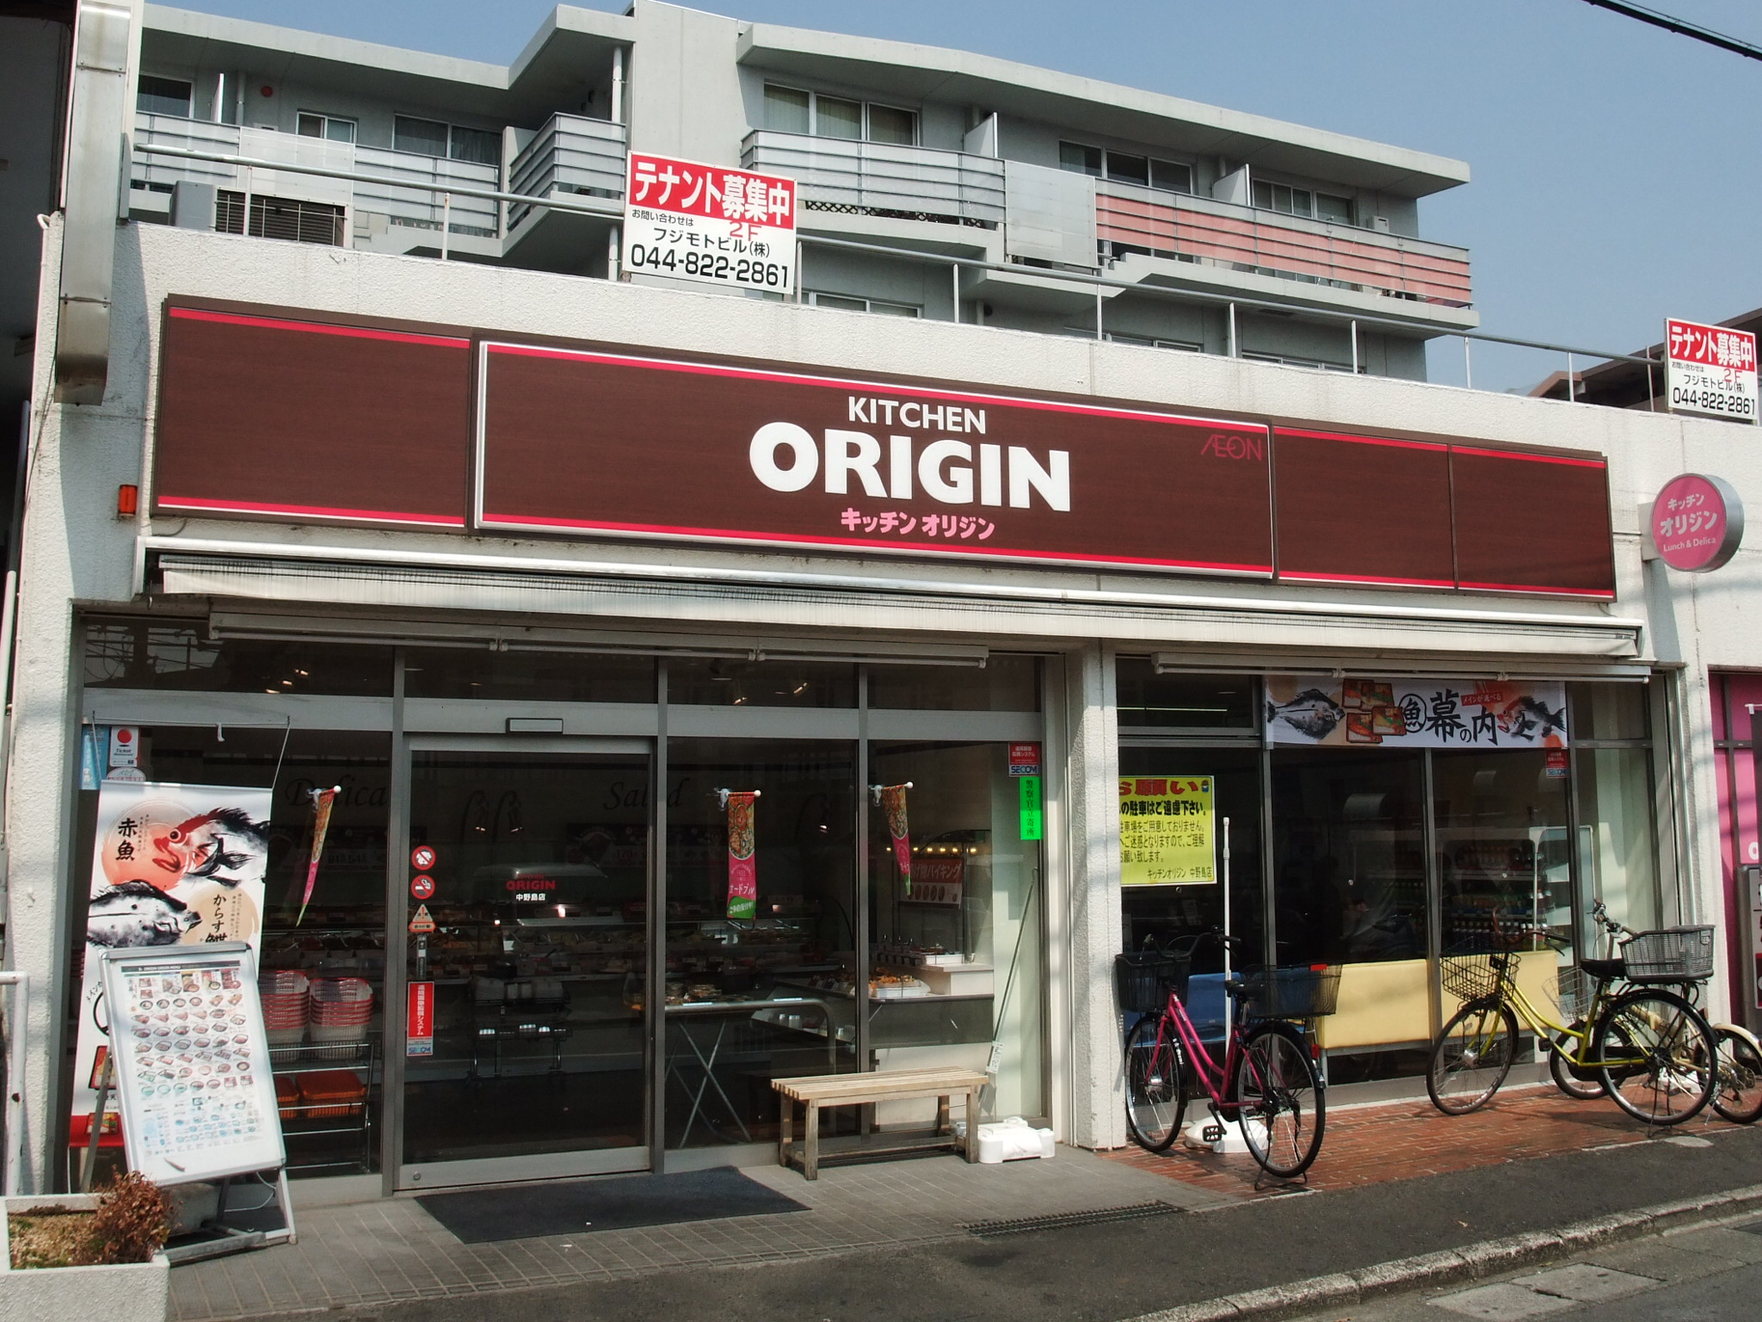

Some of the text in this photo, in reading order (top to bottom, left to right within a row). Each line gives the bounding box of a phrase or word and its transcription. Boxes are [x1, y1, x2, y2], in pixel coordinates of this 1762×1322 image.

[635, 161, 790, 226] テナント募集中
[631, 208, 694, 227] お問い合わせは
[729, 221, 762, 241] 2F
[653, 227, 770, 258] フジモトビル(株)
[630, 243, 788, 288] 044-822-2861
[1671, 325, 1753, 370] テナント募集中
[847, 395, 987, 435] KITCHEN
[1672, 387, 1755, 415] 044-822-2861
[749, 421, 1071, 513] ORIGIN
[1667, 493, 1705, 511] キッチン
[841, 507, 996, 541] キッチン オリジン
[1660, 511, 1718, 537] オリジン
[1663, 537, 1716, 552] Lunch & Delica
[1011, 765, 1037, 774] SECOM
[284, 774, 387, 807] Dlica
[602, 777, 691, 811] Sald
[1119, 800, 1206, 816] の駐車はご遠慮下さい。
[115, 817, 138, 861] 赤魚
[505, 879, 556, 891] ORIGIN
[1189, 866, 1213, 879] 中野島店
[515, 892, 546, 902] 中野島店
